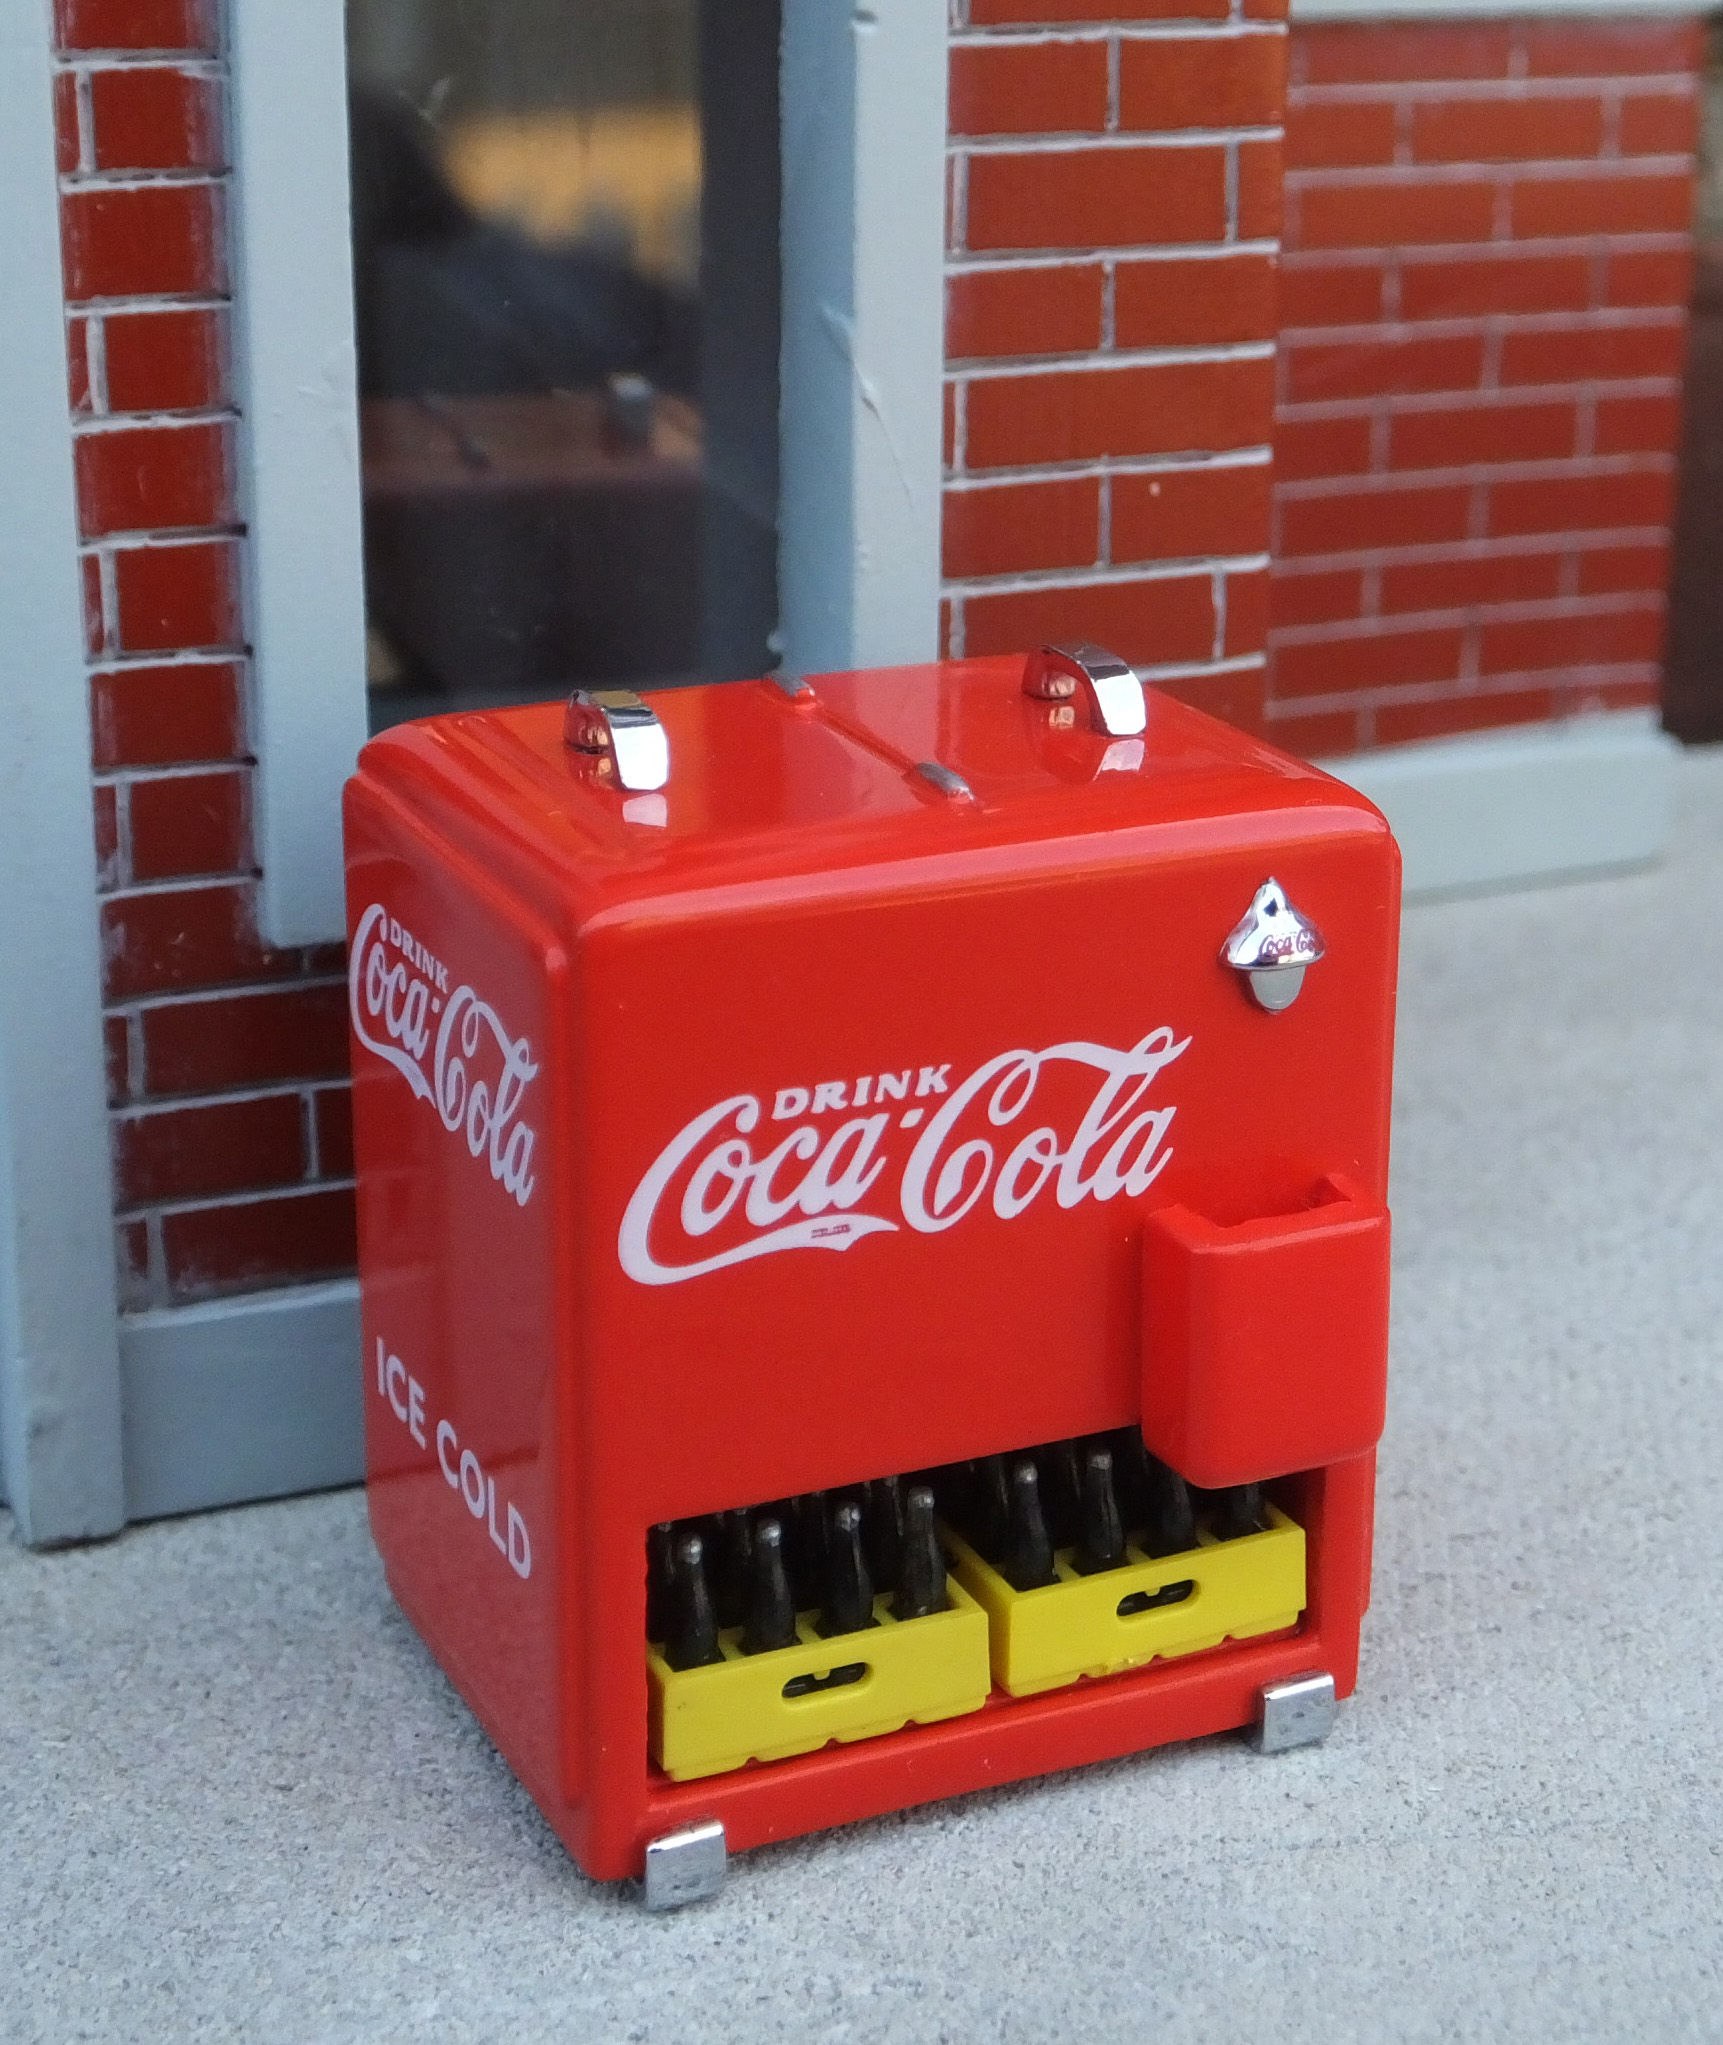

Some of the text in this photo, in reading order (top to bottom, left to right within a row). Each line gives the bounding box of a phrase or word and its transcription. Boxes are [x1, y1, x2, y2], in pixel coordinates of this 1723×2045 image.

[350, 903, 538, 1206] Coca-Cola
[391, 918, 448, 994] DRINK
[618, 1026, 1192, 1285] Coca-Cola
[772, 1065, 950, 1121] DRINK
[376, 1336, 532, 1579] ICE COLD
